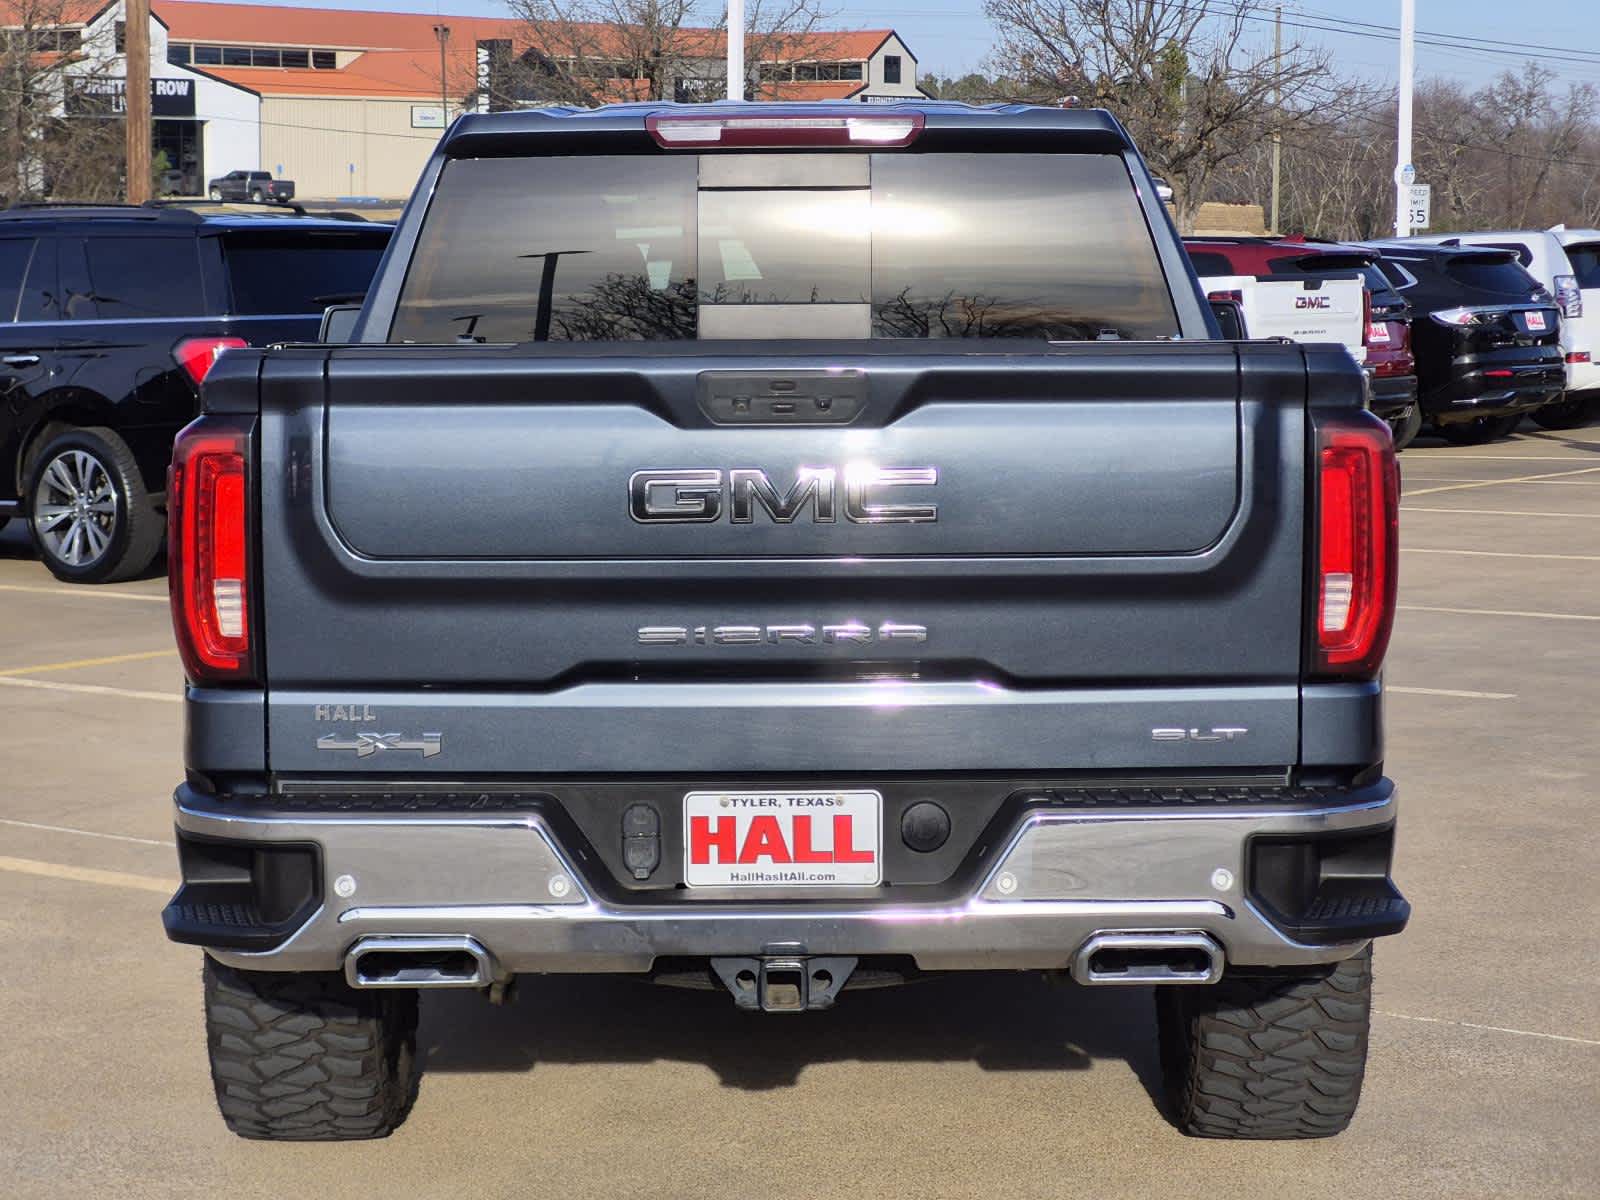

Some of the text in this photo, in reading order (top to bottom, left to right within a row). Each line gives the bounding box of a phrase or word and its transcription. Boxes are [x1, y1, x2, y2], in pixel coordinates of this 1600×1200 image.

[156, 80, 190, 96] ROW
[1295, 296, 1330, 309] GMC
[628, 468, 938, 524] GMC
[637, 625, 928, 646] SIERRA
[314, 704, 377, 721] HALL
[1151, 728, 1249, 743] SLT
[731, 797, 835, 808] TYLER, TEXAS
[690, 814, 875, 865] HALL
[730, 871, 836, 882] HallHasItAll.com
